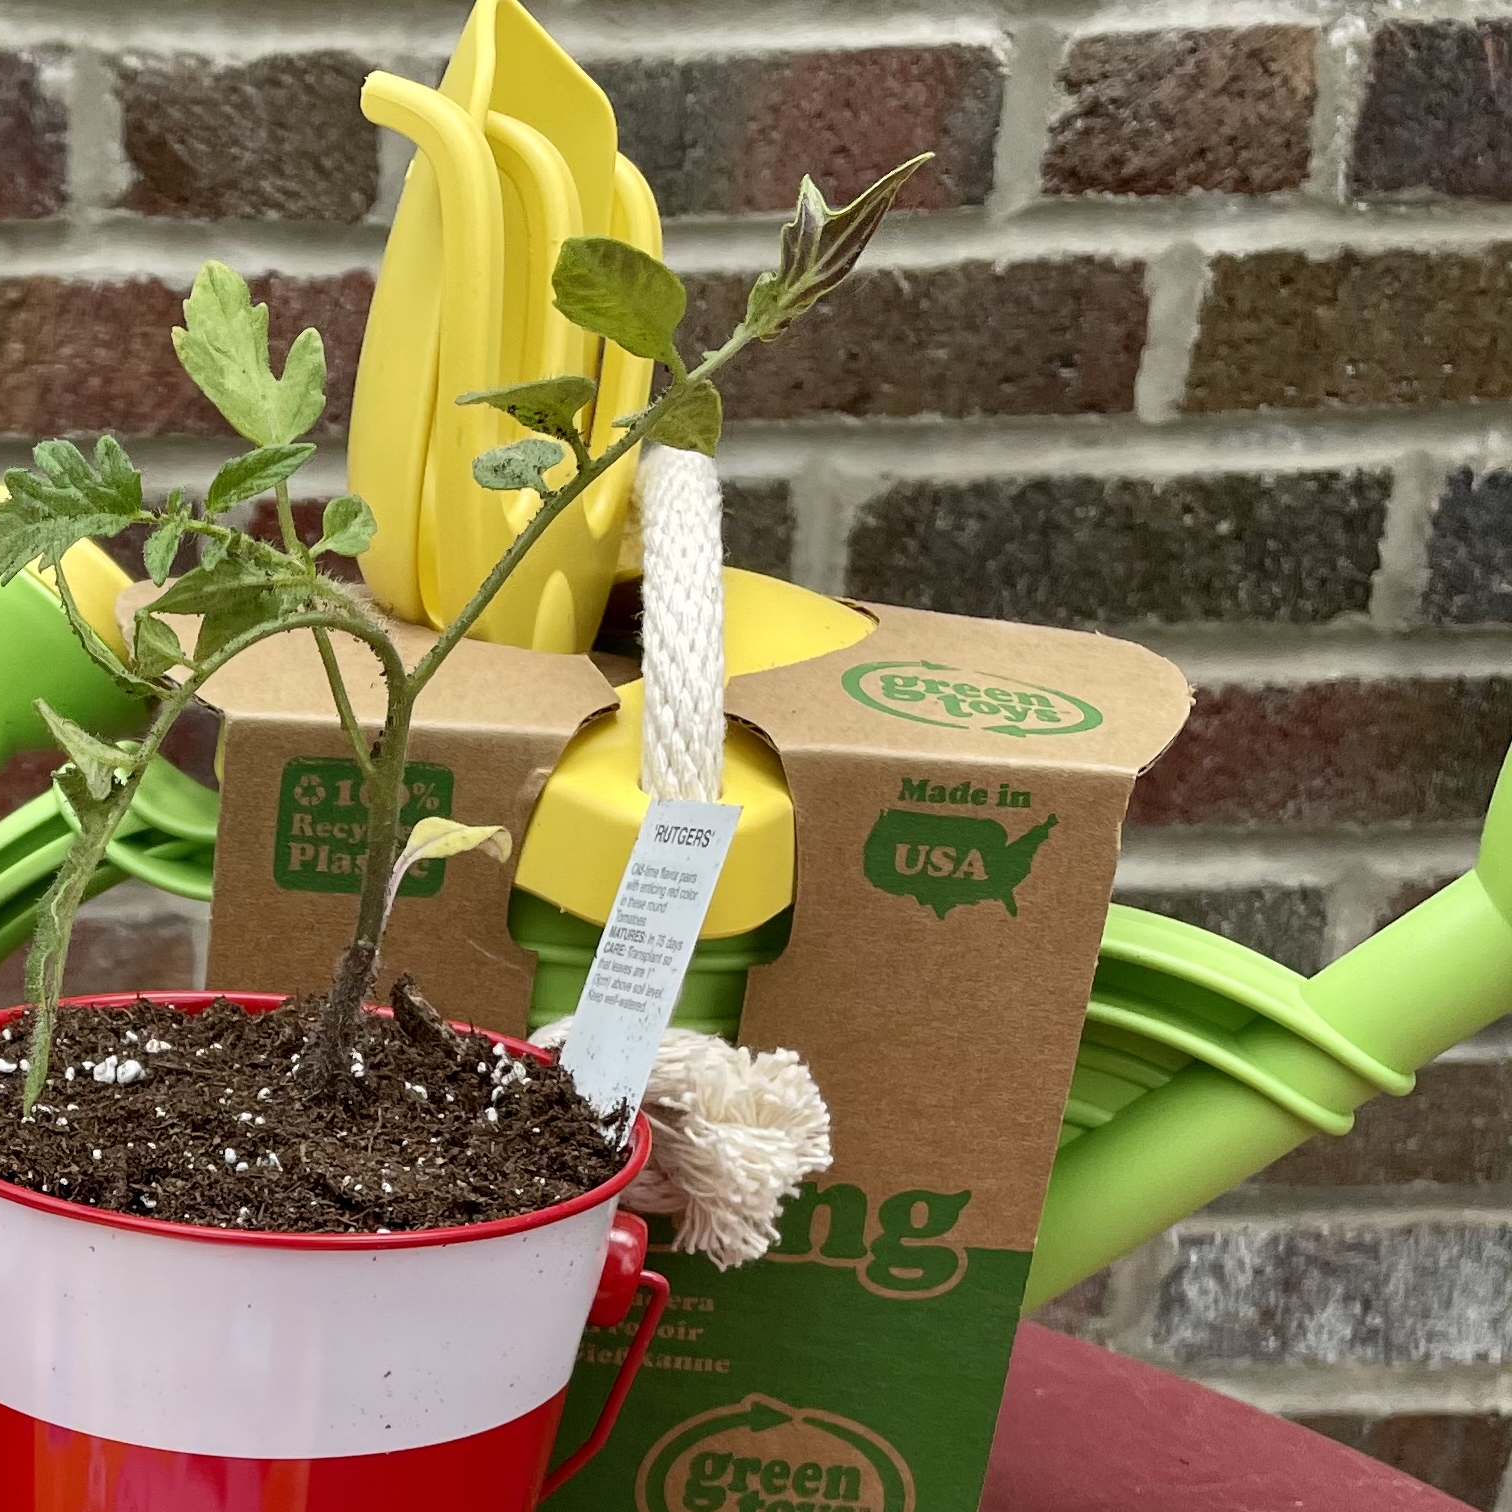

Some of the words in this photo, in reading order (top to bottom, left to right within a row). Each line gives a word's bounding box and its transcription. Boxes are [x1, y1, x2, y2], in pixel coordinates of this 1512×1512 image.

[879, 674, 1055, 708] green
[937, 693, 1062, 722] toys
[898, 777, 988, 806] Made
[996, 783, 1032, 808] in
[895, 843, 988, 880] USA
